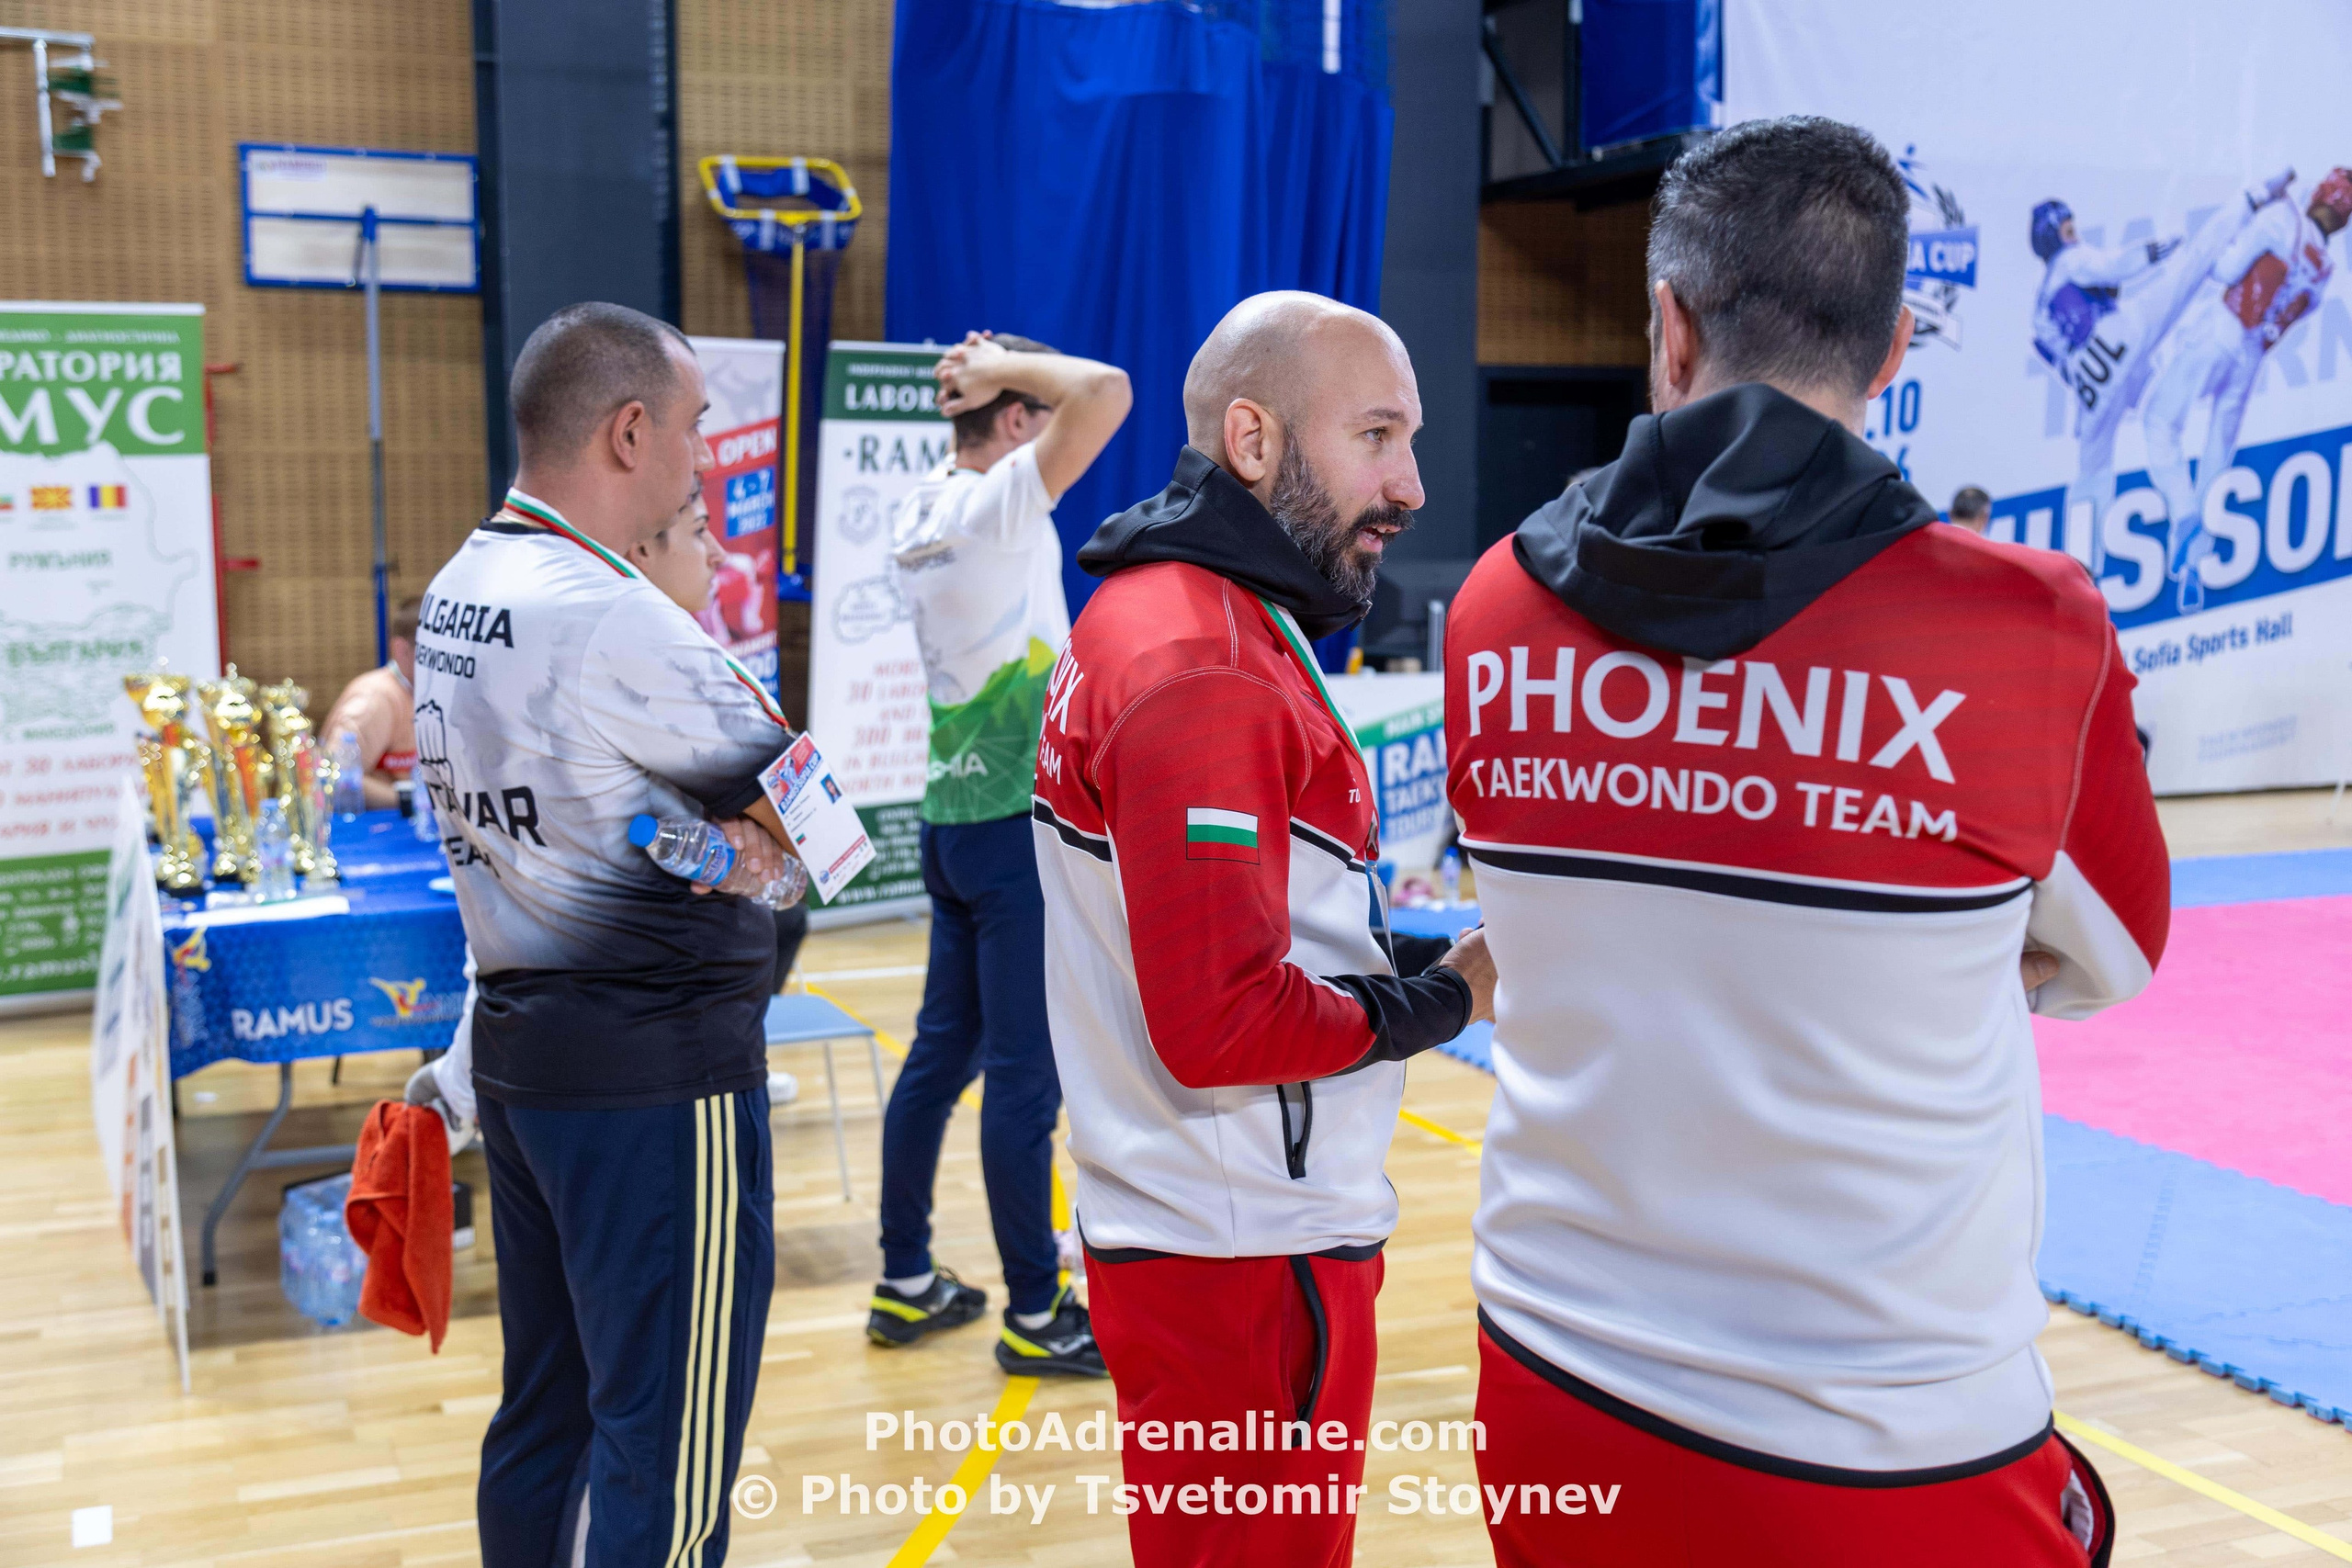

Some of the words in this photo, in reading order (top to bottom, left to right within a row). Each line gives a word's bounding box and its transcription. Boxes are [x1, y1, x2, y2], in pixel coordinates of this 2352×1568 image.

[1929, 241, 1975, 274] CUP
[845, 382, 941, 412] LABOR
[2075, 334, 2127, 411] BUL
[717, 426, 777, 467] OPEN
[418, 592, 514, 649] LGARIA
[2134, 639, 2181, 673] Sofia
[2187, 624, 2249, 662] Sports
[2255, 611, 2293, 642] Hall
[1467, 646, 1967, 784] PHOENIX
[1470, 757, 1777, 820] TAEKWONDO
[1795, 782, 1957, 842] TEAM
[231, 998, 355, 1041] RAMUS
